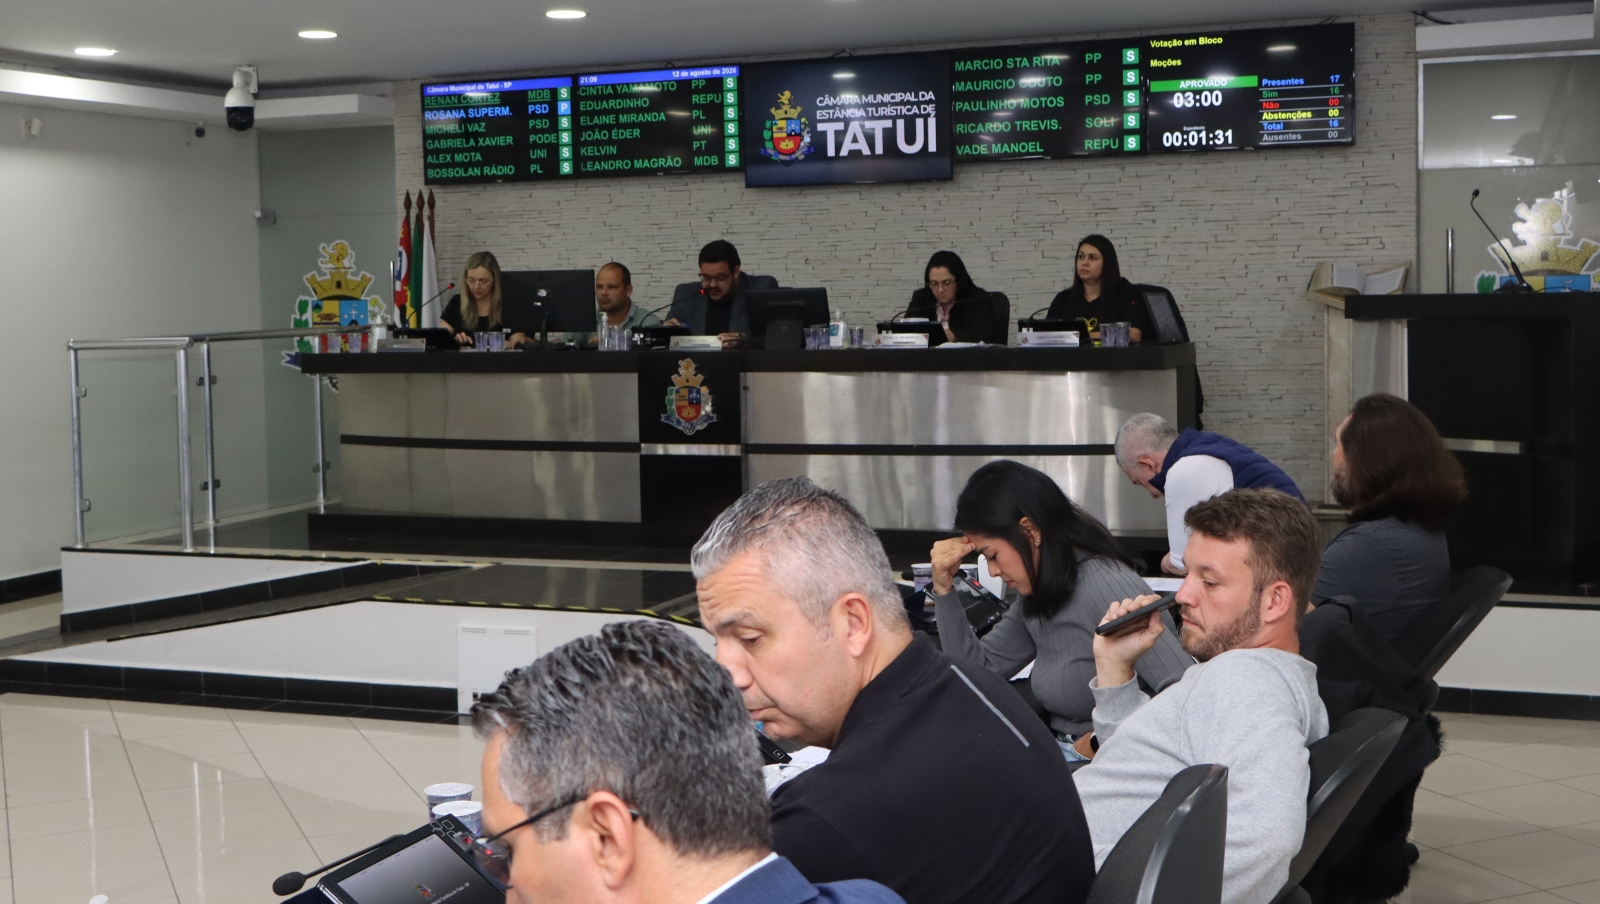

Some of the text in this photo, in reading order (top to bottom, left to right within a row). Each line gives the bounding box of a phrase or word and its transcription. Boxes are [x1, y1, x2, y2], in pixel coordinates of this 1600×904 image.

[1150, 36, 1223, 48] Votação em Bloco
[955, 51, 1135, 71] MARCIO STA RITA PP S
[1150, 58, 1182, 68] Moções
[450, 84, 476, 92] Municipal
[579, 78, 733, 96] CINTIA YAMAMOTO PP S
[955, 72, 1135, 92] MAURICIO COUTO PP S
[1179, 78, 1227, 89] APROVADO
[1262, 75, 1340, 86] Presentes 17
[425, 95, 458, 105] RENAN
[528, 89, 550, 99] MDB
[561, 88, 567, 97] S
[580, 93, 734, 110] EDUARDINHO REPU S
[816, 91, 935, 106] CÂMARA MUNICIPAL DA
[956, 93, 1135, 111] PAULINHO MOTOS PSD S
[1173, 90, 1222, 108] 03:00
[1329, 98, 1339, 106] 00
[425, 103, 568, 120] ROSANA SUPERM. PSD P
[580, 108, 734, 125] ELAINE MIRANDA PL S
[817, 104, 936, 119] ESTÂNCIA TURÍSTICA DE
[1262, 111, 1312, 120] Abstenções
[426, 118, 568, 134] MICHELI VAZ PSD S
[580, 123, 734, 140] JOÃO ÉDER UNI S
[956, 116, 1135, 134] RICARDO TREVIS. SOLI S
[1262, 122, 1284, 130] Total
[426, 133, 568, 149] GABRIELA XAVIER PODE S
[817, 113, 937, 157] TATUÍ
[1163, 129, 1232, 147] 00:01:31
[1263, 133, 1301, 141] Ausentes
[580, 139, 735, 156] KELVIN PT S
[956, 138, 1136, 155] VADE MANOEL REPU S
[427, 148, 569, 163] ALEX MOTA UNI S
[581, 155, 736, 171] LEANDRO MAGRÃO MDB S
[427, 163, 570, 178] BOSSOLAN RÁDIO PL S
